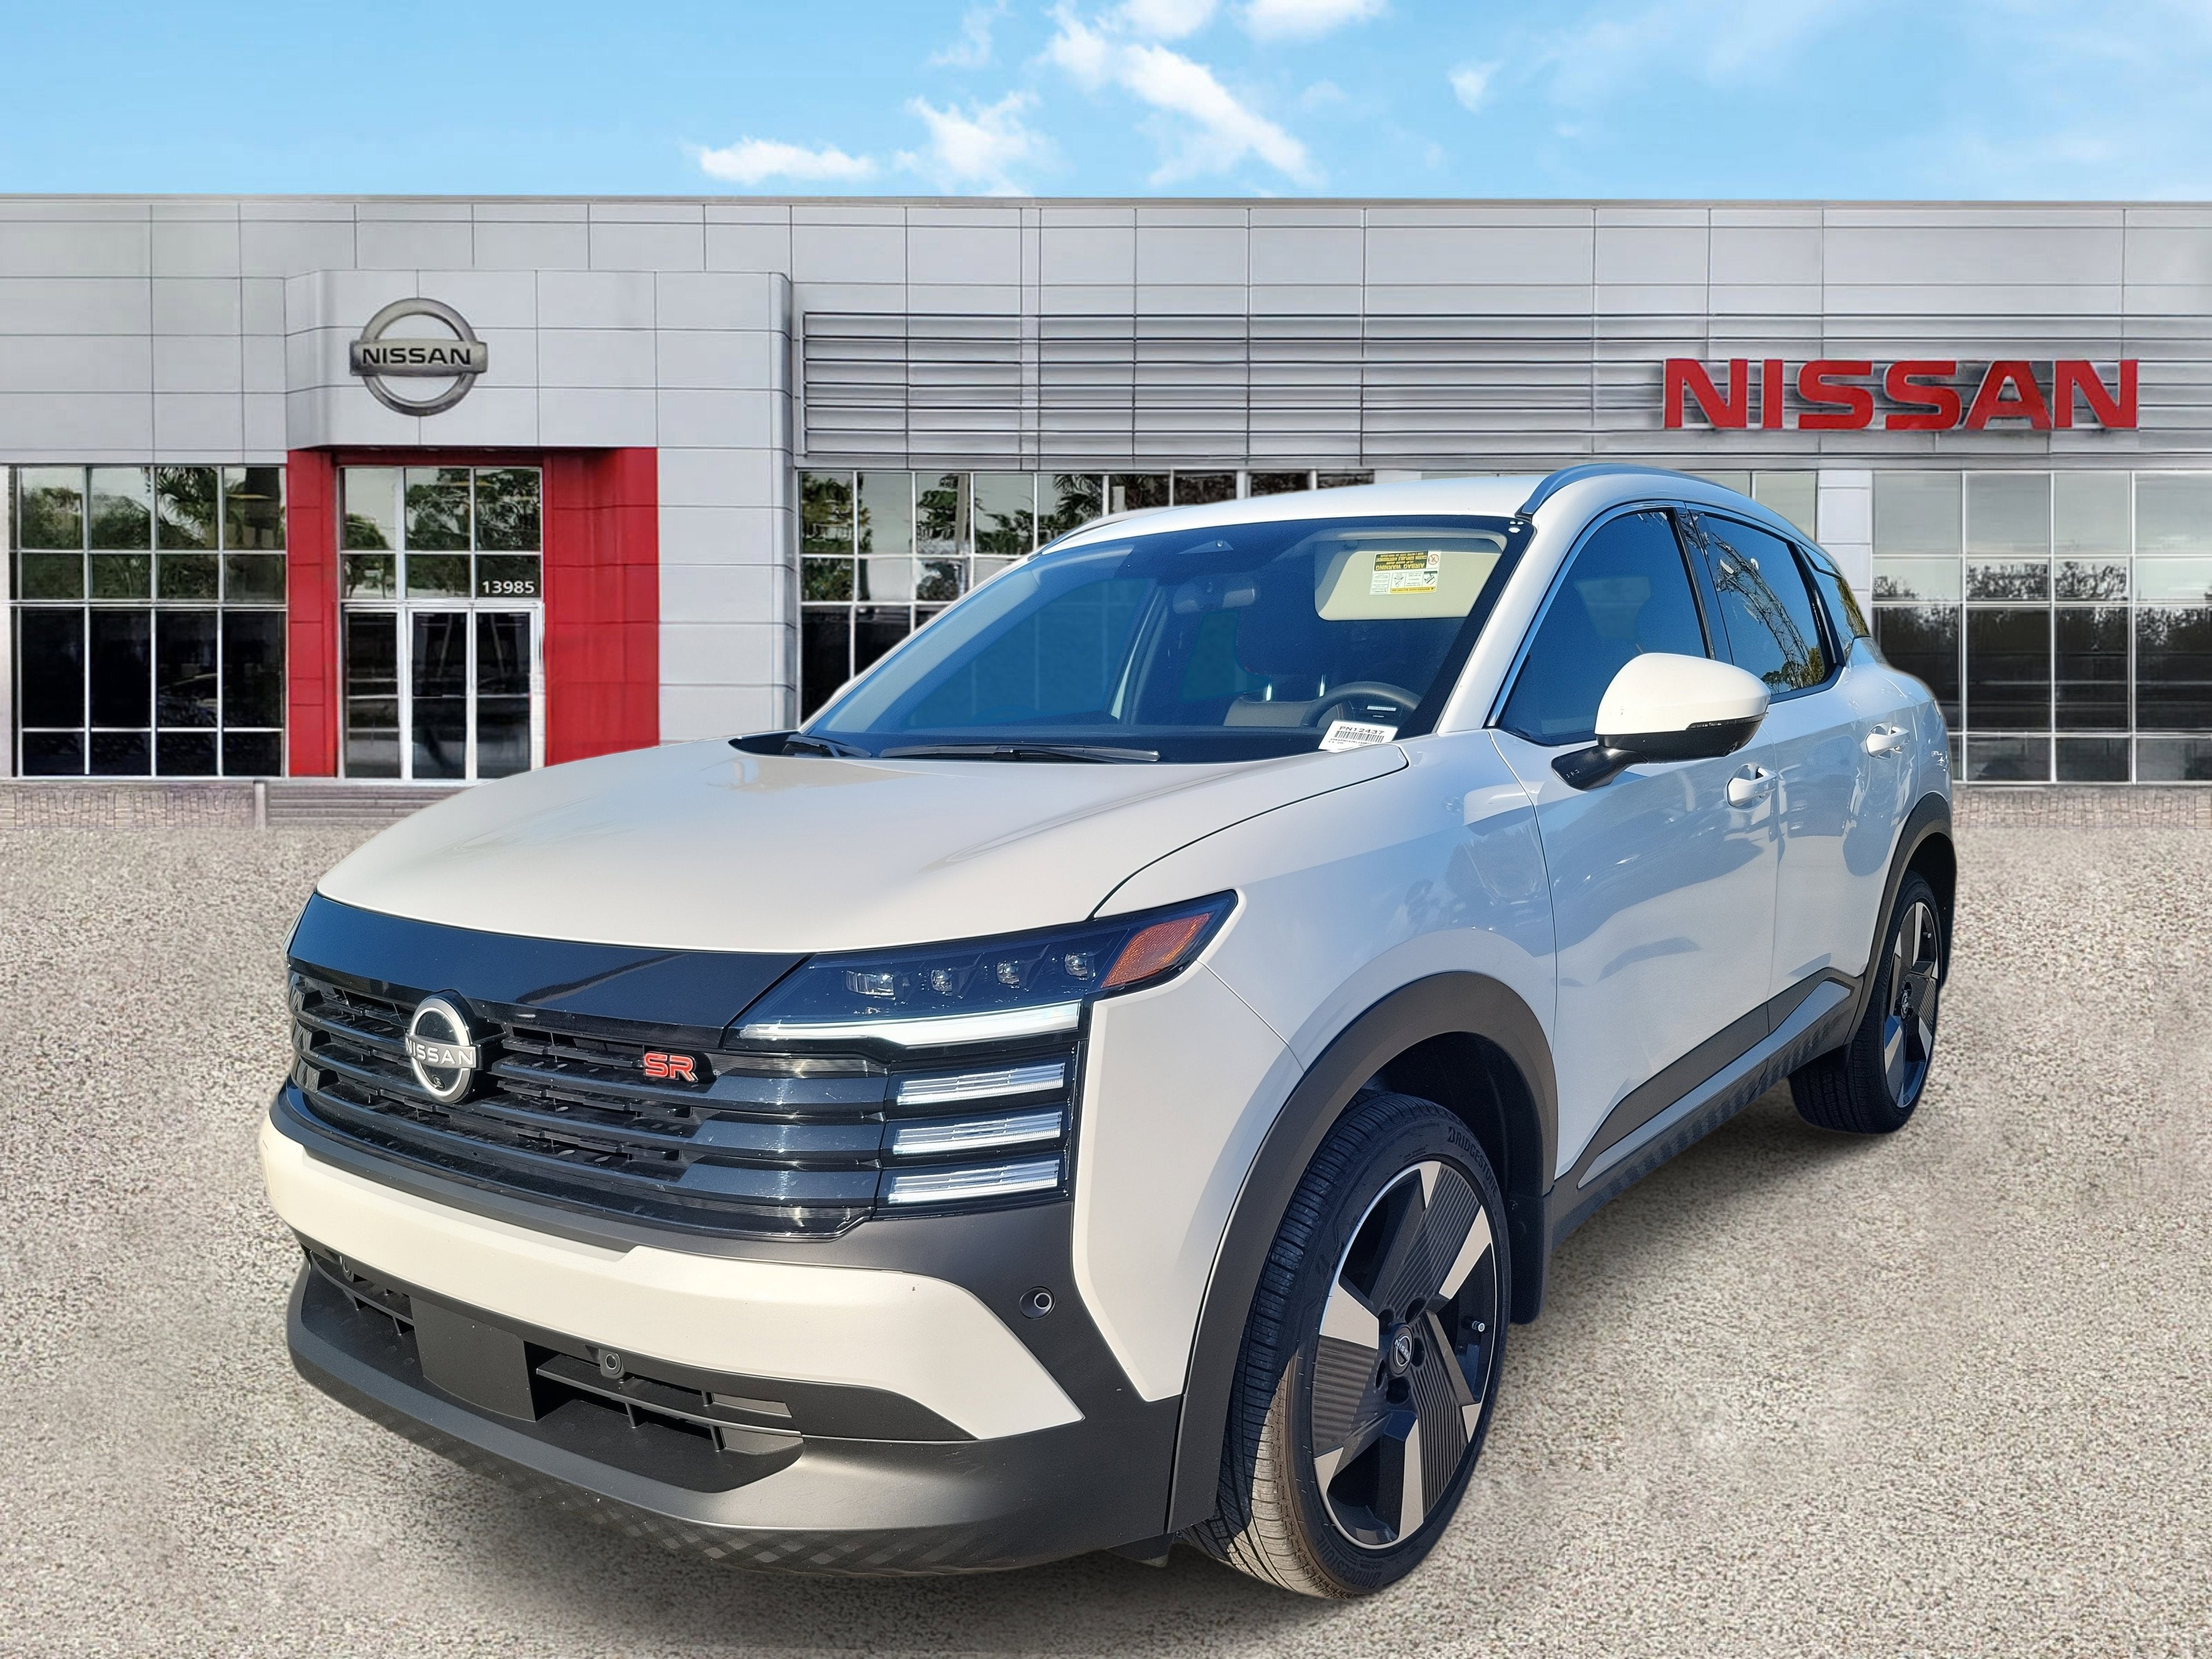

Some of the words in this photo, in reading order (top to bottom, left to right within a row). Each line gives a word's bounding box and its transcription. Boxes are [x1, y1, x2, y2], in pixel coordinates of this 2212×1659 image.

[362, 348, 472, 366] NISSAN
[1664, 358, 2138, 430] NISSAN
[482, 580, 535, 594] 13985
[1339, 726, 1385, 735] PN12437
[406, 1037, 473, 1066] NISSAN
[643, 1051, 698, 1082] SR
